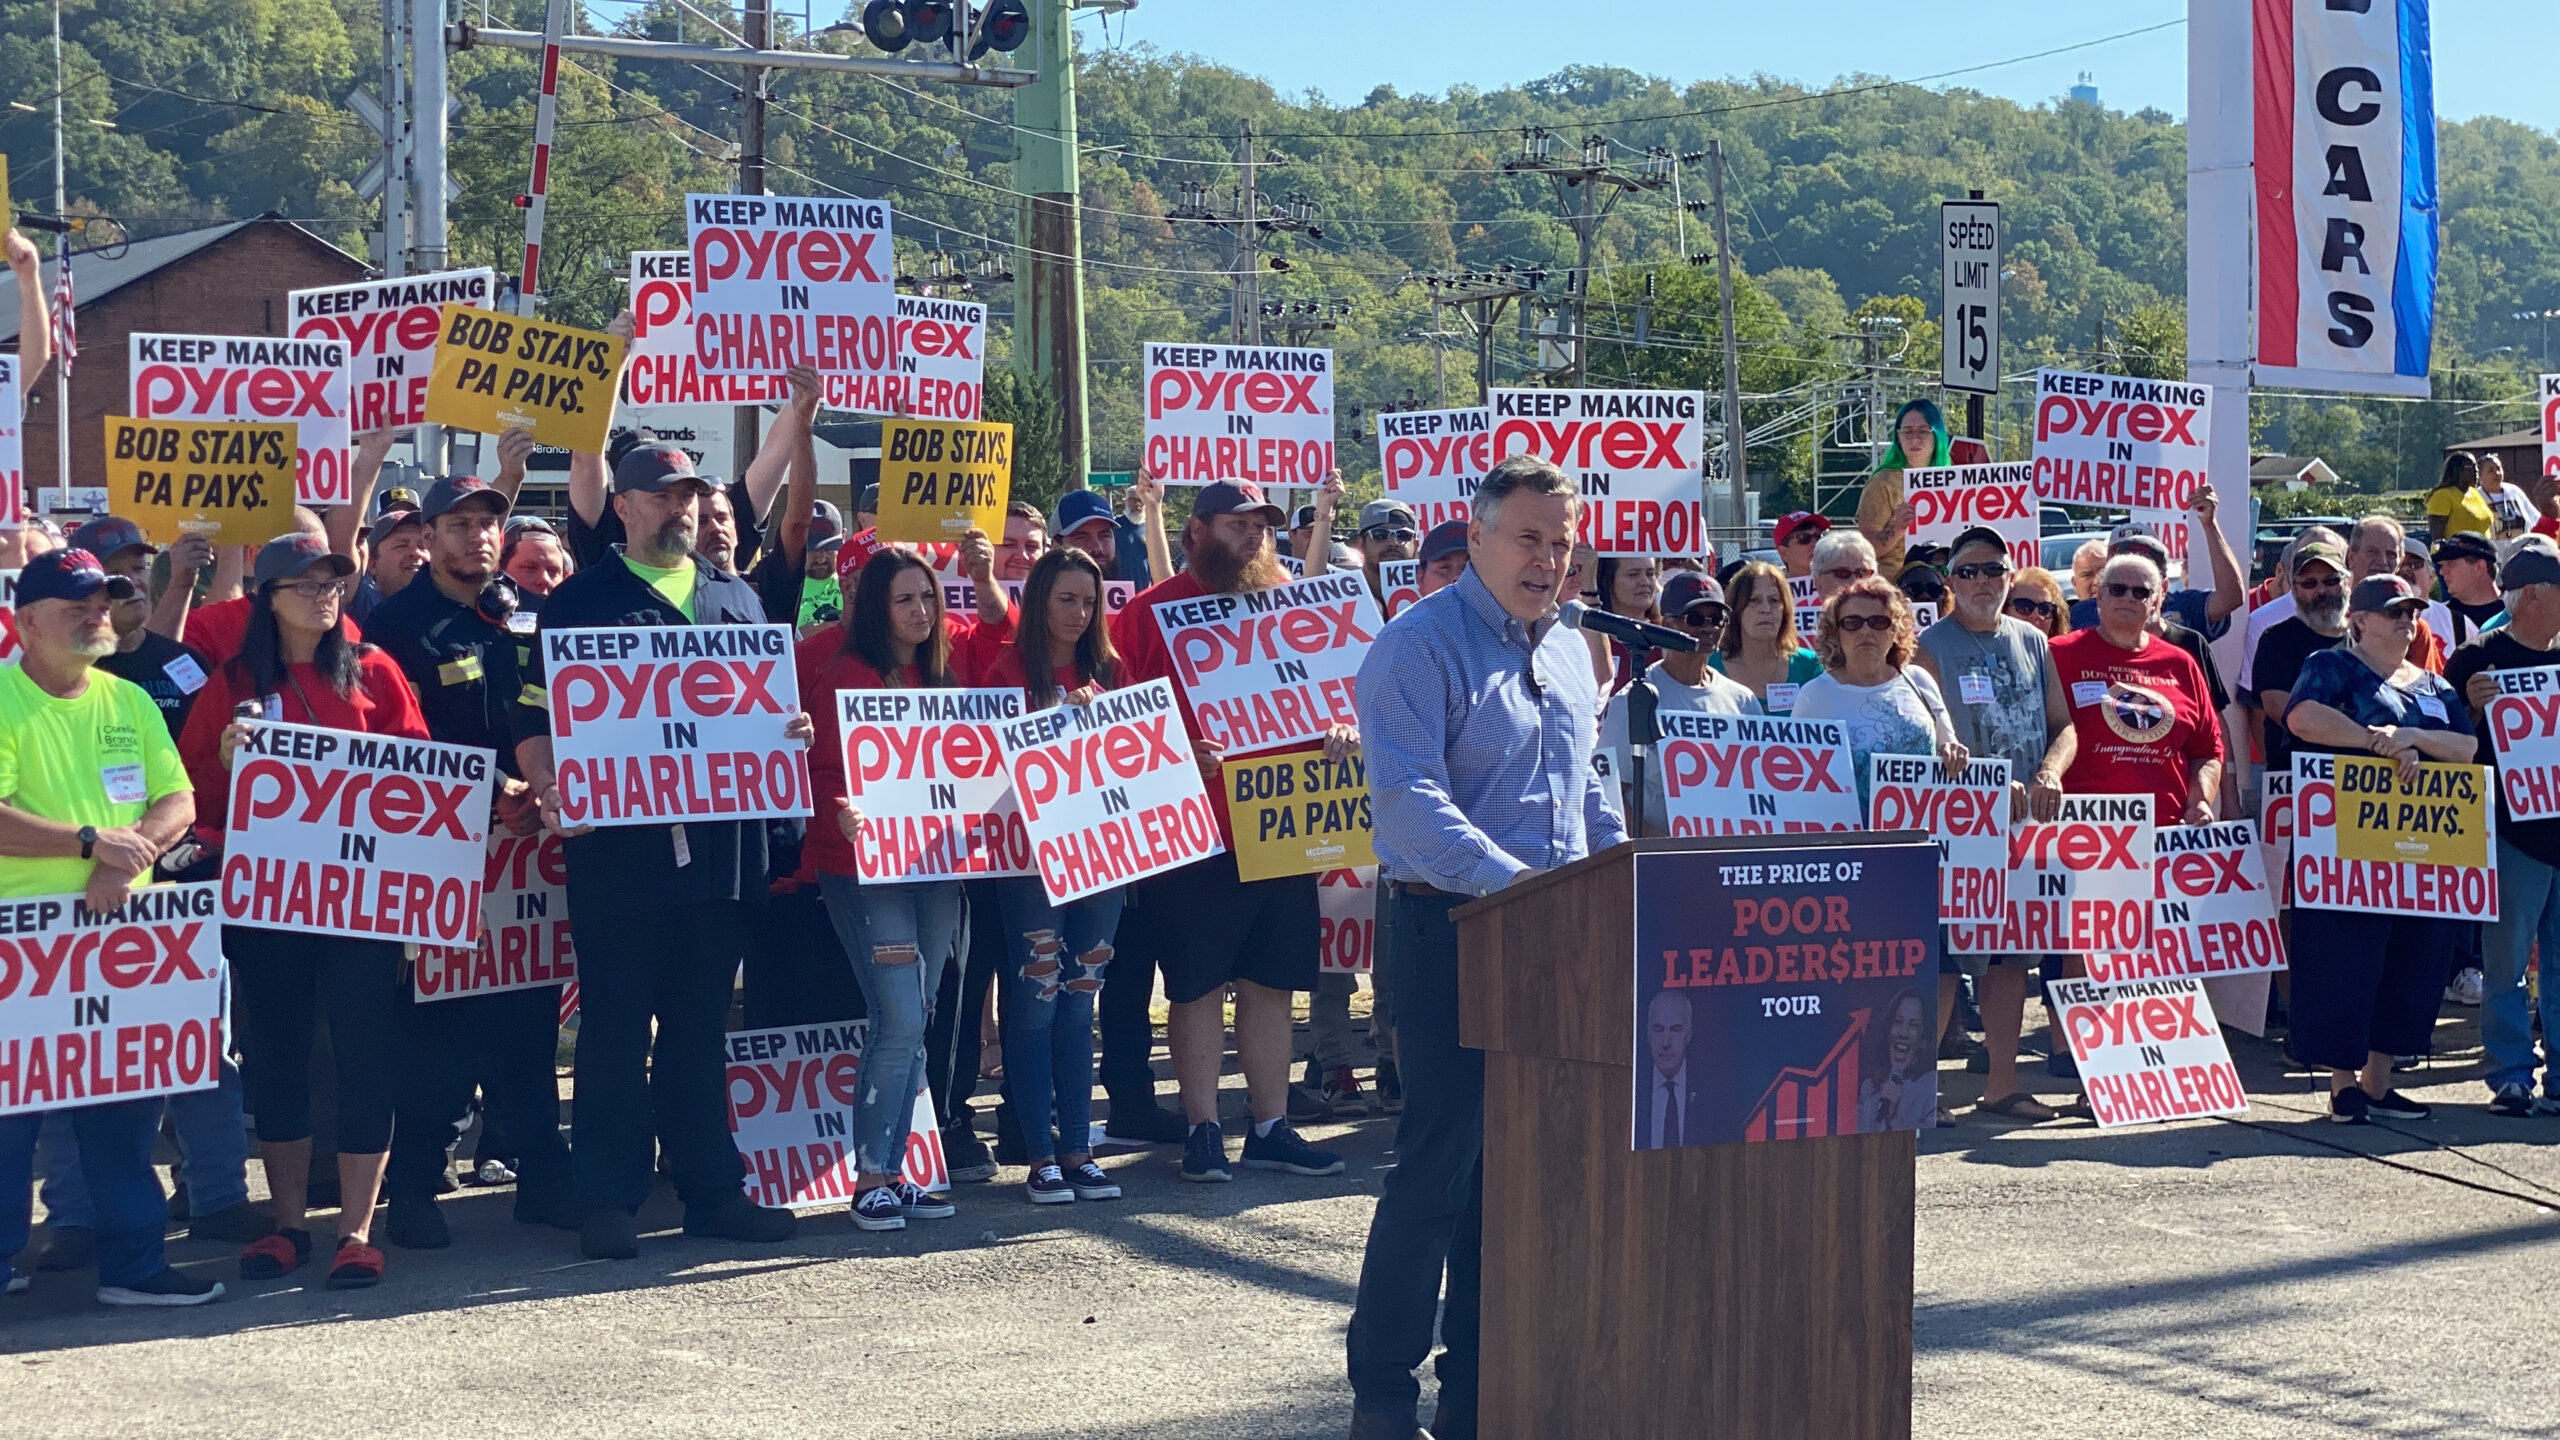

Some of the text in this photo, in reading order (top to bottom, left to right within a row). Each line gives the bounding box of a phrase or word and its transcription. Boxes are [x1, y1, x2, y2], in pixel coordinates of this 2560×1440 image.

[695, 200, 885, 230] KEEP MAKING
[2315, 67, 2382, 349] CARS
[1949, 220, 1994, 250] SPEED
[640, 257, 690, 278] KEE
[695, 227, 880, 293] pyrex
[1954, 261, 1989, 290] LIMIT
[298, 277, 487, 317] KEEP MAKING
[782, 285, 810, 310] IN
[898, 298, 982, 325] MAKING
[139, 338, 343, 367] KEEP MAKING
[447, 312, 611, 381] BOB STAYS,
[697, 314, 898, 371] CHARLEROI
[896, 320, 974, 358] rex
[1957, 305, 1988, 371] 15
[377, 355, 404, 379] IN
[1153, 347, 1325, 373] KEEP MAKING
[136, 364, 336, 418] pyrex
[458, 358, 585, 415] PA PAY$.
[1150, 369, 1318, 420] pyrex
[2043, 375, 2206, 406] KEEP MAKING
[1228, 414, 1253, 435] IN
[1385, 414, 1442, 436] KEEP
[1496, 395, 1695, 418] KEEP MAKING
[2038, 395, 2196, 447] pyrex
[115, 426, 289, 470] BOB STAYS,
[890, 428, 1008, 469] BOB STAYS,
[1148, 434, 1333, 484] CHARLEROI
[1386, 434, 1488, 490] pyre
[2109, 442, 2133, 462] IN
[134, 471, 173, 506] PA
[181, 474, 268, 508] PAY$.
[903, 471, 999, 511] PA PAY$.
[1583, 474, 1610, 495] IN
[1909, 464, 2032, 488] KEEP MAKING
[1577, 500, 1700, 553] RLEROI
[1161, 597, 1236, 629] KEEP
[1245, 576, 1362, 613] MAKING
[551, 630, 785, 661] KEEP MAKING
[1173, 601, 1374, 687] pyrex
[1274, 658, 1308, 684] IN
[552, 660, 783, 737] pyrex
[845, 696, 1019, 722] KEEP MAKING
[1198, 673, 1356, 753] CHARLE
[663, 722, 697, 748] IN
[1003, 685, 1171, 751] KEEP MAKING
[1662, 715, 1841, 746] KEEP MAKING
[245, 727, 486, 781] KEEP MAKING
[1015, 714, 1181, 821] pyrex
[1664, 740, 1841, 798] pyrex
[1876, 760, 1925, 783] KEEP
[2300, 758, 2334, 779] KE
[558, 749, 811, 821] CHARLEROI
[930, 784, 956, 809] IN
[1236, 756, 1366, 802] BOB STAY
[2341, 764, 2393, 794] BOB
[231, 759, 473, 841] pyrex
[1102, 785, 1130, 815] IN
[1750, 795, 1776, 816] IN
[2357, 801, 2389, 830] PA
[2397, 803, 2464, 837] PAY$.
[1259, 806, 1295, 842] PA
[340, 832, 376, 863] IN
[856, 811, 1037, 878] CHARLERO
[1038, 793, 1223, 899] CHARLEROI
[2008, 824, 2142, 871] yrex
[1719, 862, 1862, 885] THE PRICE OF
[2039, 874, 2066, 896] IN
[2155, 849, 2256, 899] rex
[2297, 854, 2498, 917] CHARLEROI
[222, 853, 483, 943] CHARLEROI
[516, 892, 547, 920] IN
[1939, 867, 2005, 920] LEROI
[2162, 902, 2190, 923] IN
[0, 901, 61, 932] EEP
[1733, 896, 1850, 937] POOR
[415, 921, 574, 990] CHARLE
[1663, 938, 1926, 988] LEADER$HIP
[75, 995, 110, 1026] IN
[1762, 995, 1821, 1017] TOUR
[796, 1026, 869, 1054] MAKI
[2066, 995, 2209, 1062] pyrex
[0, 1017, 219, 1108] HARLEROI
[2140, 1045, 2166, 1066] IN
[726, 1054, 857, 1133] pyre
[2087, 1062, 2246, 1125] CHARLEROI
[815, 1112, 845, 1138] IN
